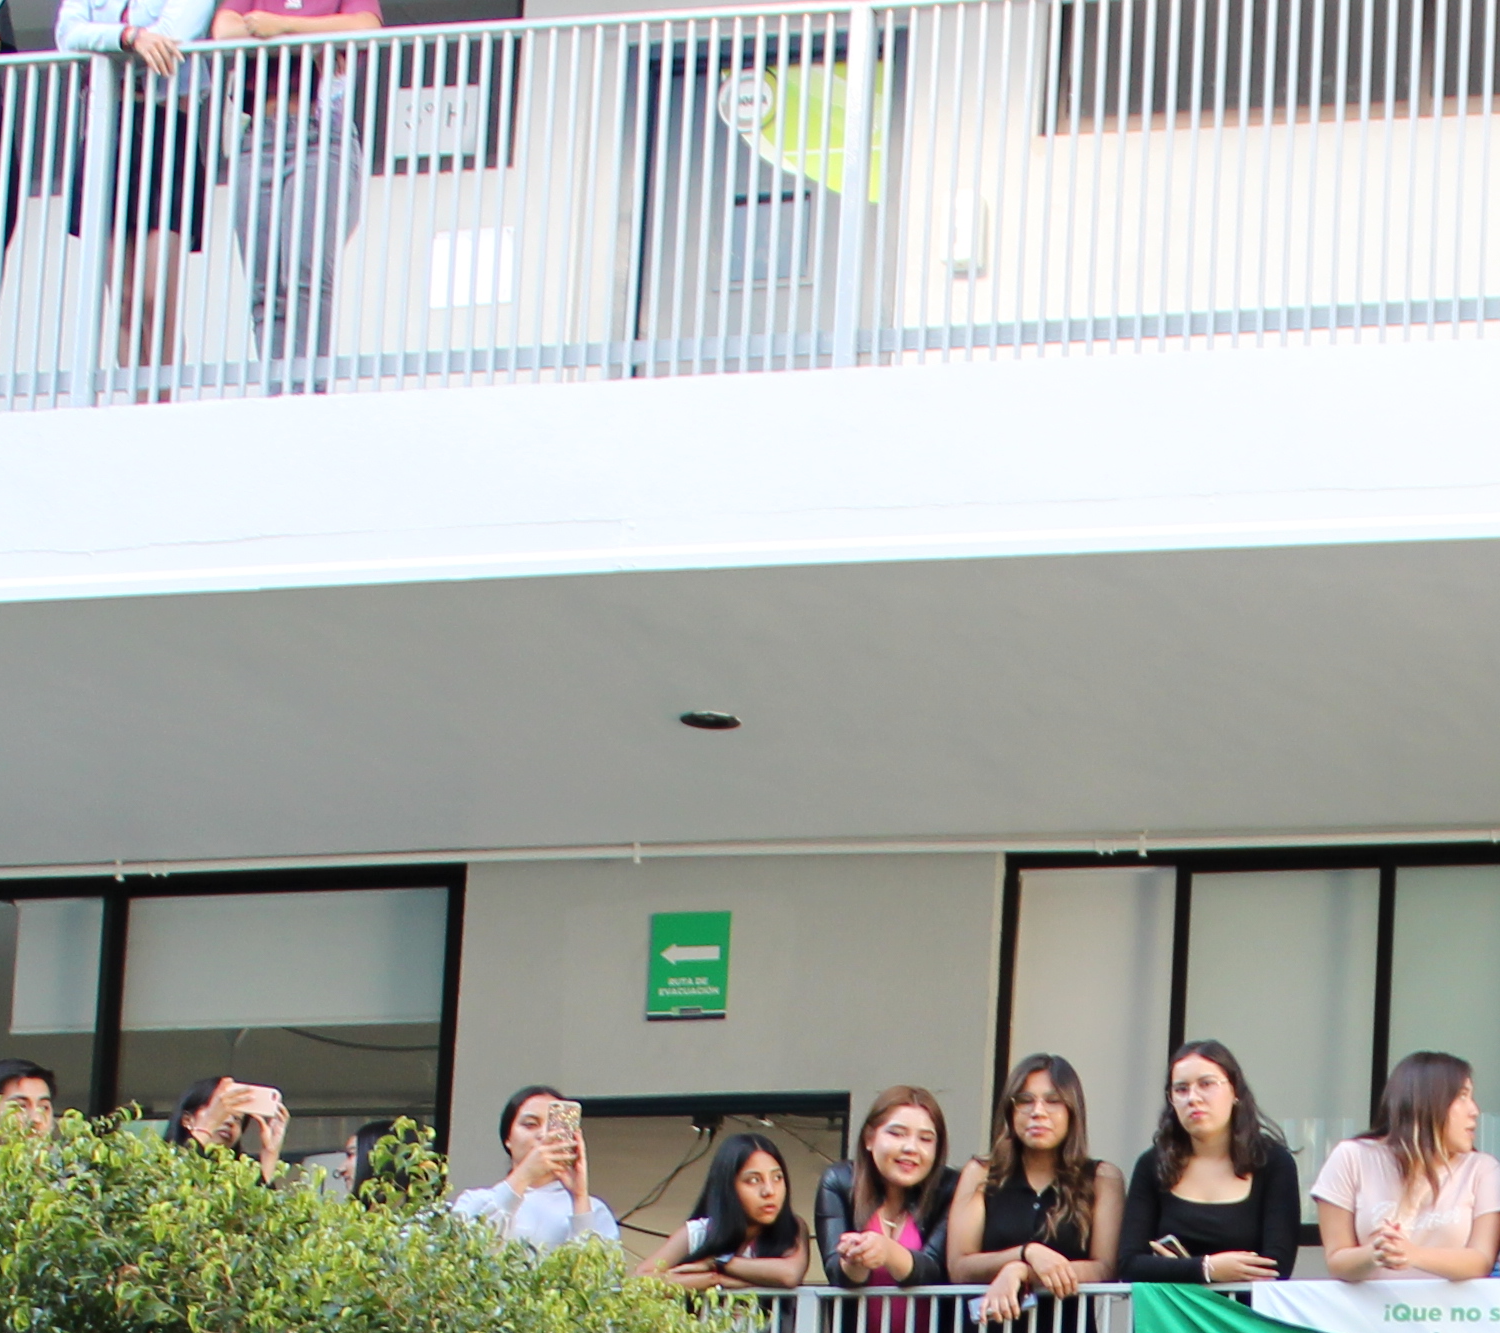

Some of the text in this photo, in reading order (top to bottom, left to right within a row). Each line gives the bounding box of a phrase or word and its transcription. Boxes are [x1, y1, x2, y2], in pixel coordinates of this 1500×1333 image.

[667, 976, 710, 987] RUTA DE
[1384, 1303, 1442, 1323] ¡Que
[1450, 1307, 1482, 1322] no
